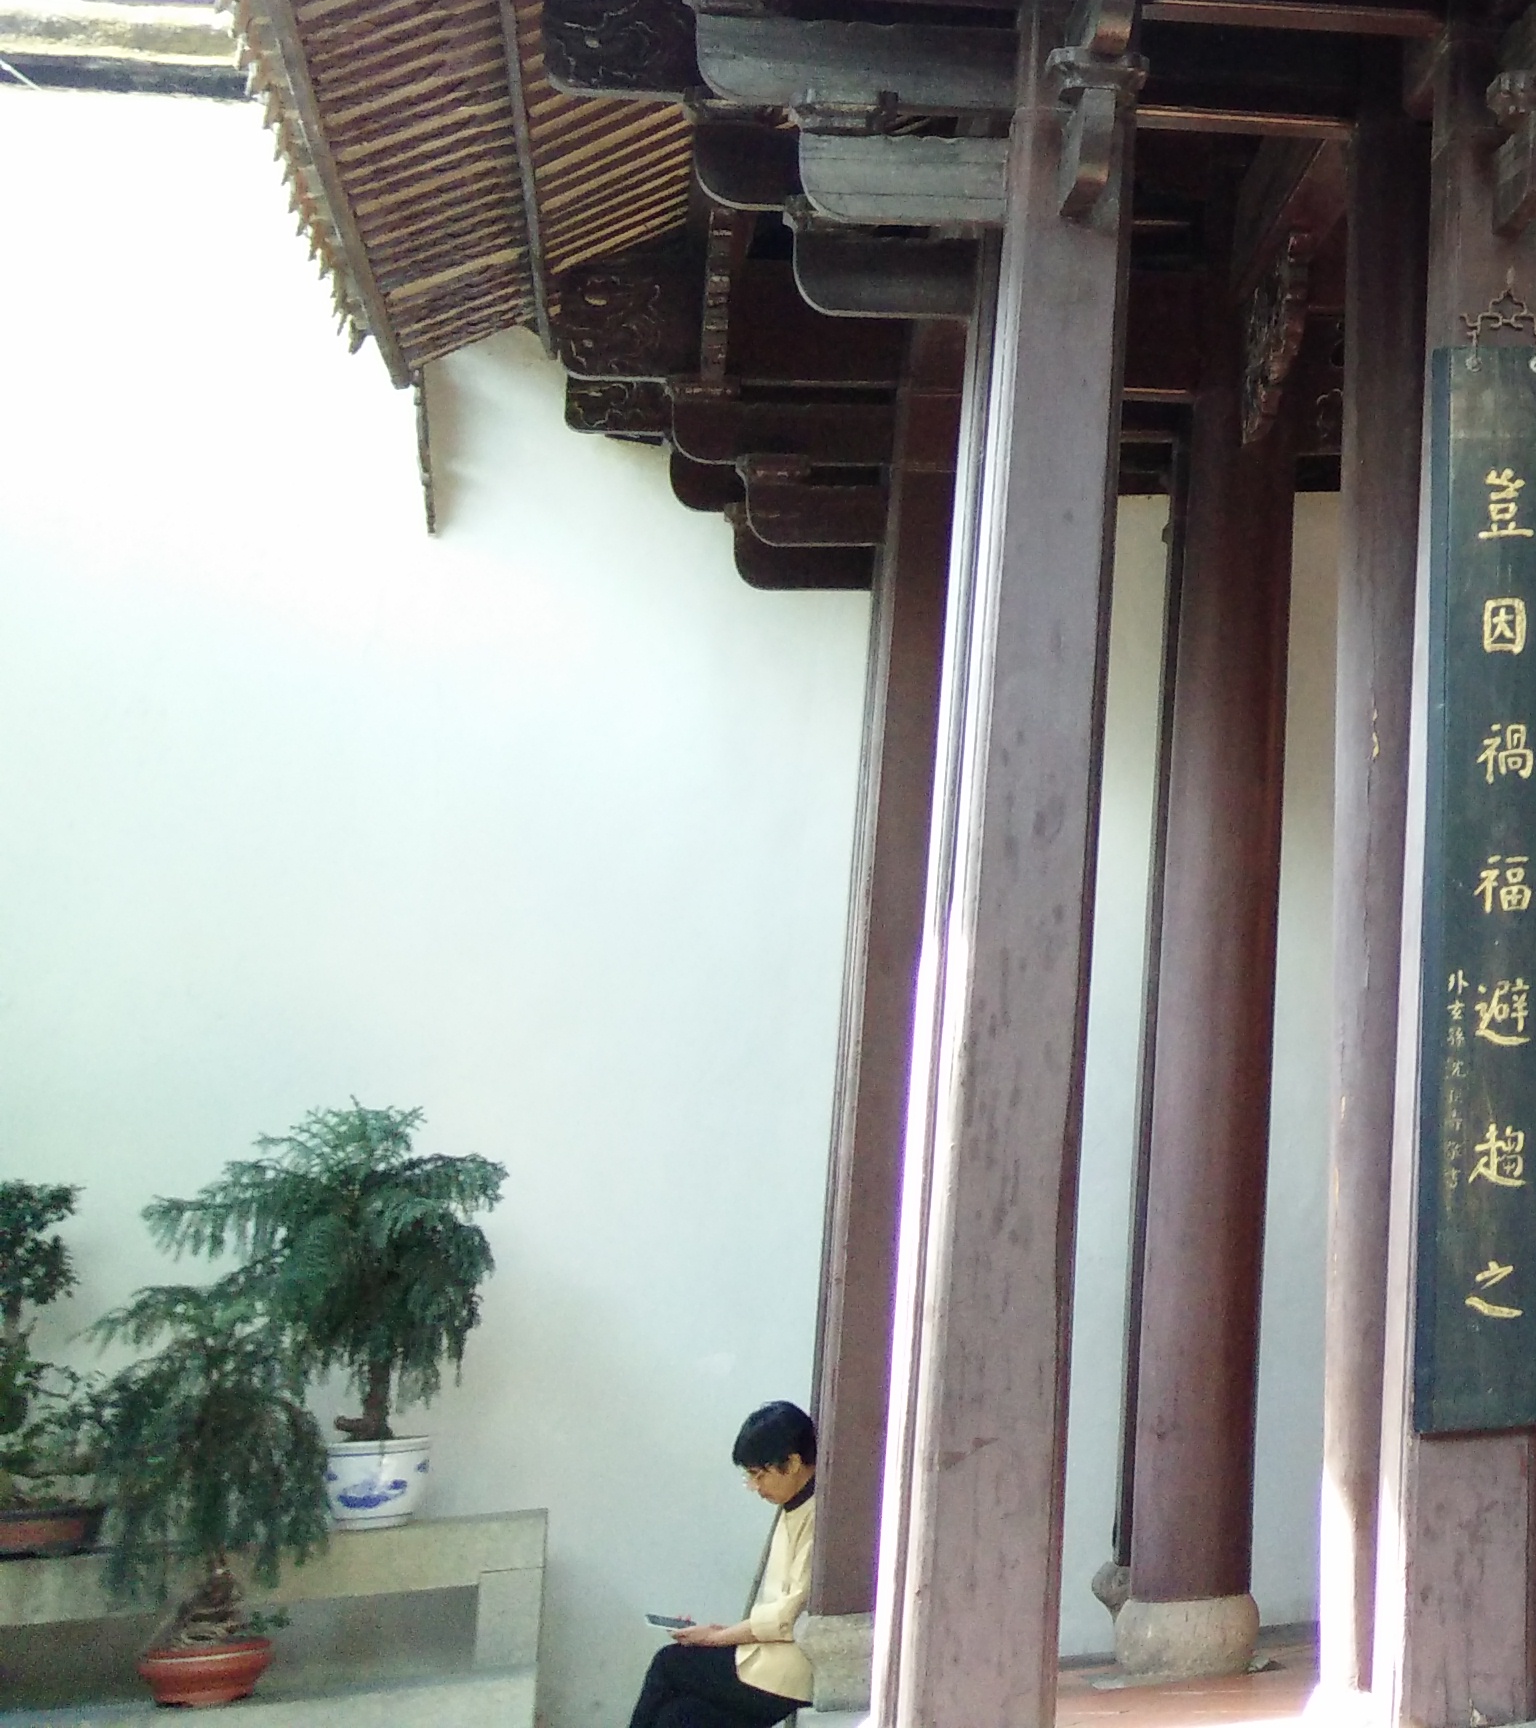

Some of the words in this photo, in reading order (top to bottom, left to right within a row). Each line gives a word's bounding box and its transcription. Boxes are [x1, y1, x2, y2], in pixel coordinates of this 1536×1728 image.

[1464, 468, 1534, 1319] 豈因禍福避趨之
